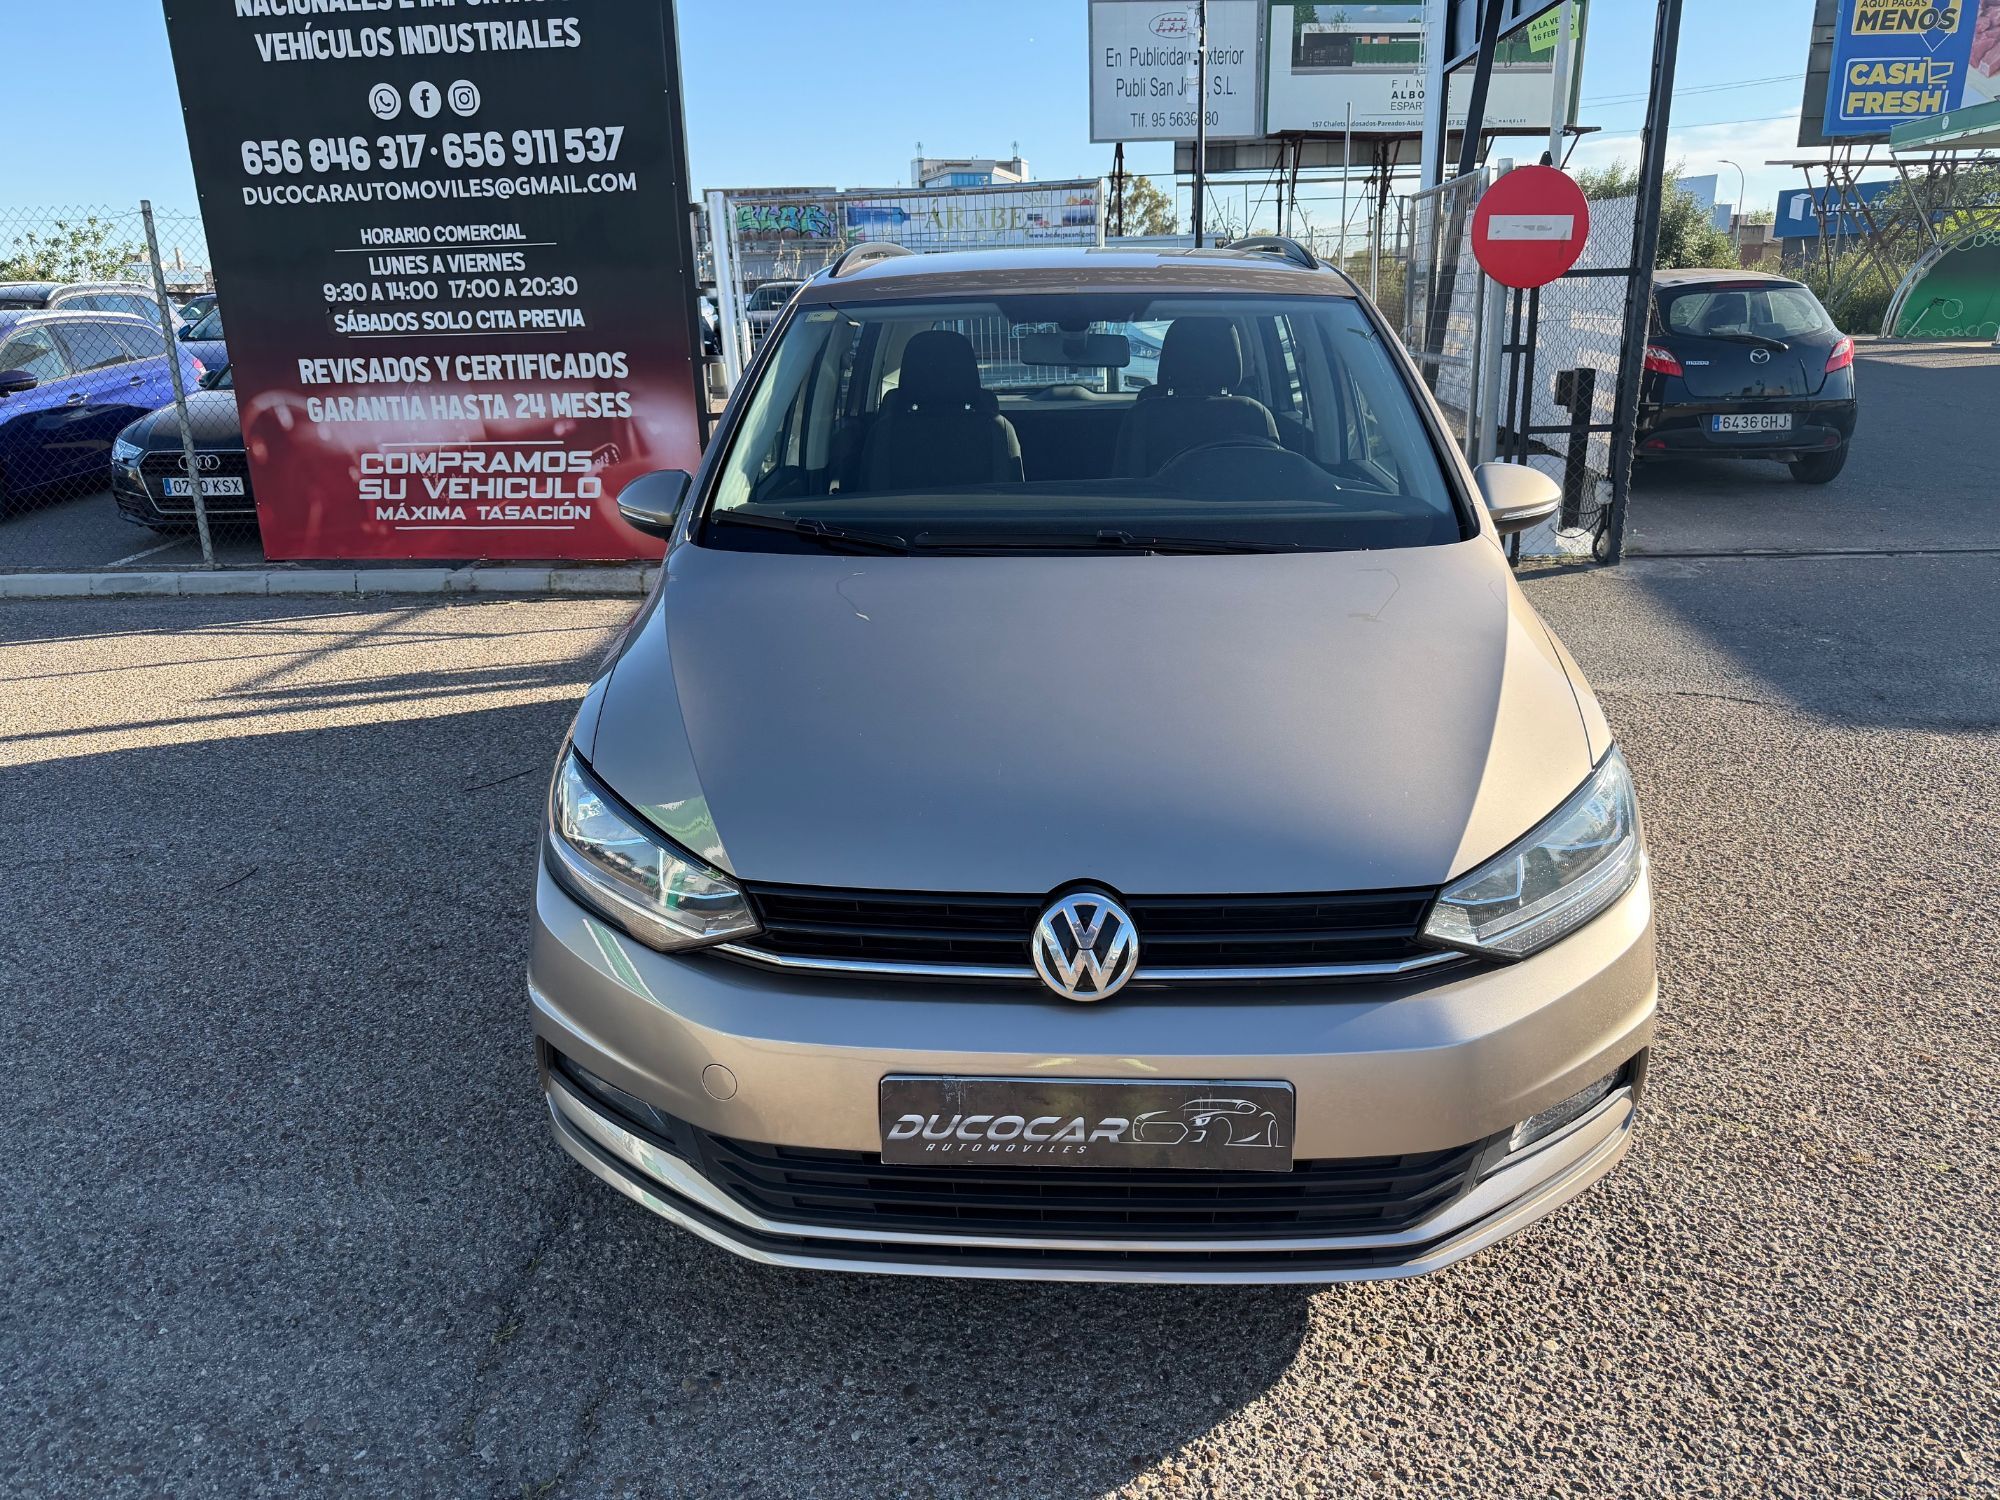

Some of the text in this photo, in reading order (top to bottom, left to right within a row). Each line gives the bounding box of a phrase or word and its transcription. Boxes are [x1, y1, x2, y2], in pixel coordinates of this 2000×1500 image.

[1538, 20, 1549, 29] LA
[1856, 8, 1957, 31] MENOS
[254, 18, 581, 62] VEHÍCULOS INDUSTRIALES
[1533, 34, 1542, 42] 16
[1106, 48, 1122, 67] En
[1204, 46, 1244, 65] xterior
[1849, 63, 1927, 85] CASH
[1116, 79, 1146, 97] Publi
[1150, 77, 1174, 96] San
[1213, 75, 1237, 95] S.L.
[1846, 90, 1942, 114] FRESH
[1131, 110, 1219, 127] Tlf. 95 563080
[1323, 119, 1346, 127] Chalets
[242, 139, 303, 175] 656
[308, 136, 371, 173] 846
[443, 132, 505, 169] 656
[512, 129, 558, 166] 911
[564, 126, 625, 163] 537
[242, 173, 637, 206] DUCOCARAUTOMOVILES@GMAIL.COM
[360, 223, 526, 245] HORARIO COMERCIAL
[369, 252, 526, 275] LUNES A VIERNES
[323, 276, 578, 302] 9:30 A 14:00 17:00 A 20:30
[333, 308, 585, 333] SÁBADOS SOLO CITA PREVIA
[298, 351, 628, 384] REVISADOS Y CERTIFICADOS
[306, 392, 633, 423] GARANTIA HASTA 24 MESES
[1722, 415, 1788, 429] 6436 GHJ
[360, 451, 593, 475] COMPRAMOS
[173, 479, 241, 493] 070 KSX
[358, 476, 602, 500] SU VEHICULO
[376, 502, 591, 521] MÁXIMA TASACIÓN
[886, 1113, 1130, 1143] DUCOCAR
